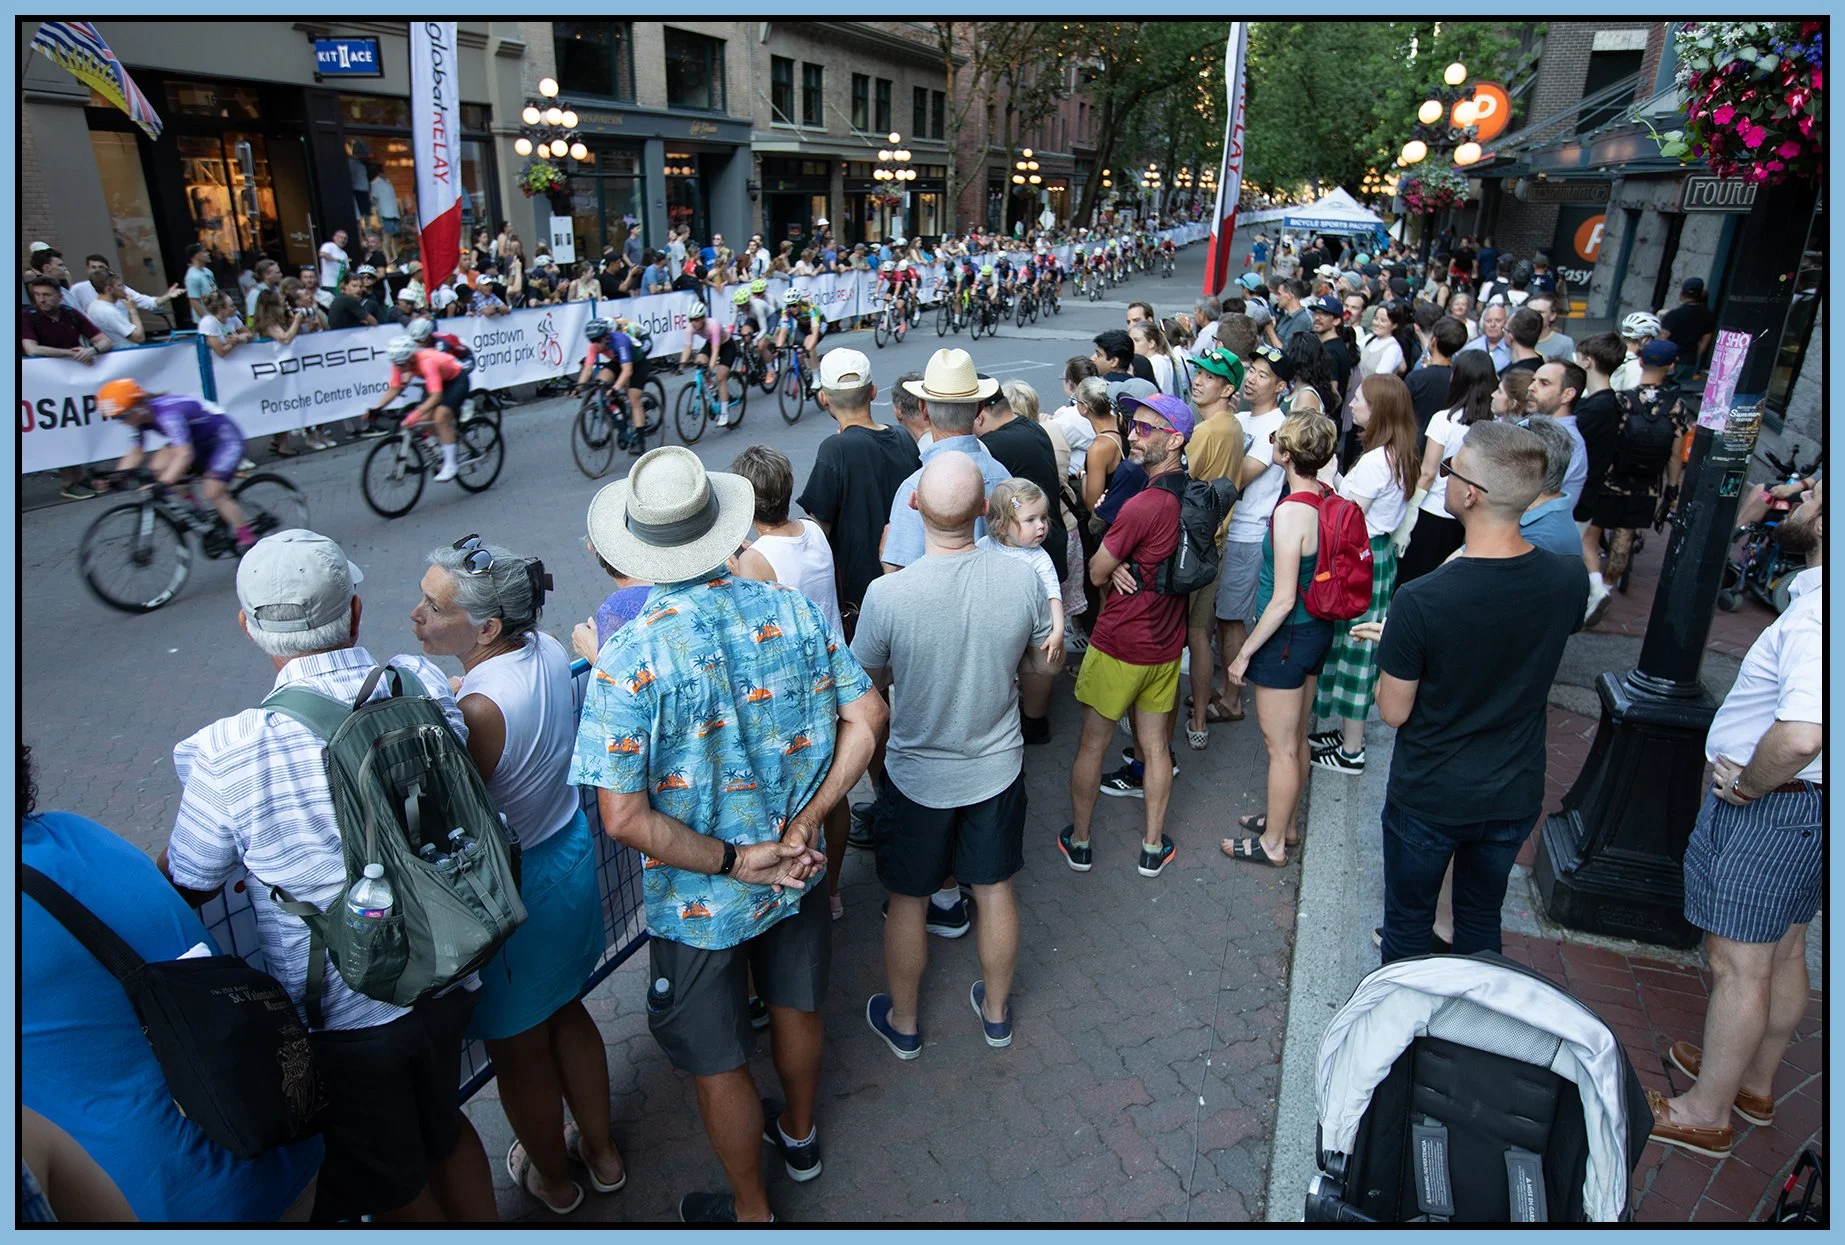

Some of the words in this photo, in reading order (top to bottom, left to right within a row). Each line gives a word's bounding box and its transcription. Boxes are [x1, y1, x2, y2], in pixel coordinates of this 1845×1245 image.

[317, 51, 337, 62] KIT
[350, 51, 372, 62] ACE
[1691, 181, 1759, 205] POURH
[1290, 218, 1319, 228] BICYCLE
[1320, 220, 1348, 230] SPORTS
[1349, 222, 1375, 231] PACIFIC
[473, 328, 524, 353] gastown
[251, 346, 387, 380] PORSCH
[477, 345, 512, 373] grand
[515, 343, 535, 367] prix
[261, 394, 312, 414] Porsche
[314, 383, 352, 405] Centre
[353, 381, 390, 397] Vanco
[22, 394, 108, 433] OSAP
[1528, 1206, 1536, 1222] GARD
